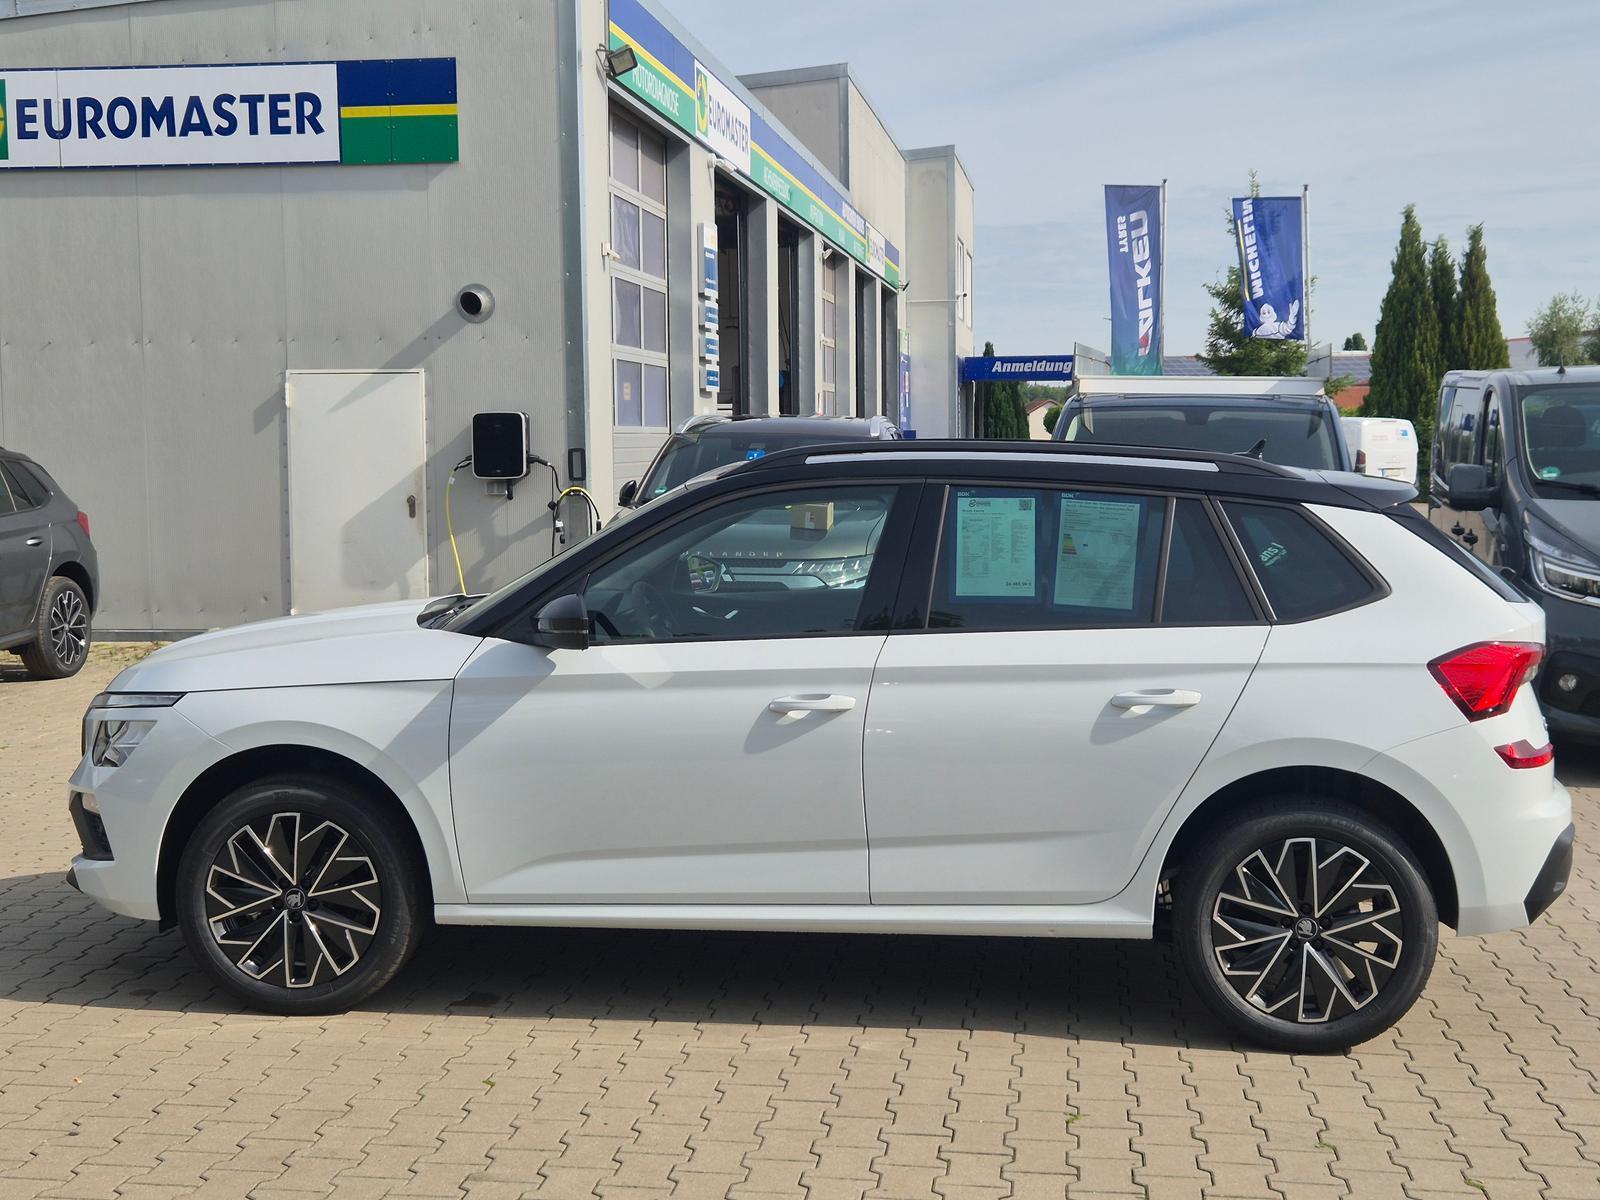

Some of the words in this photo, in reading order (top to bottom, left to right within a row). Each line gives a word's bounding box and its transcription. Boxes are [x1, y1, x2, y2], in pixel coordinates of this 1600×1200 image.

[16, 91, 325, 140] EUROMASTER
[708, 95, 750, 153] EUROMASTER
[991, 360, 1073, 374] Anmeldung
